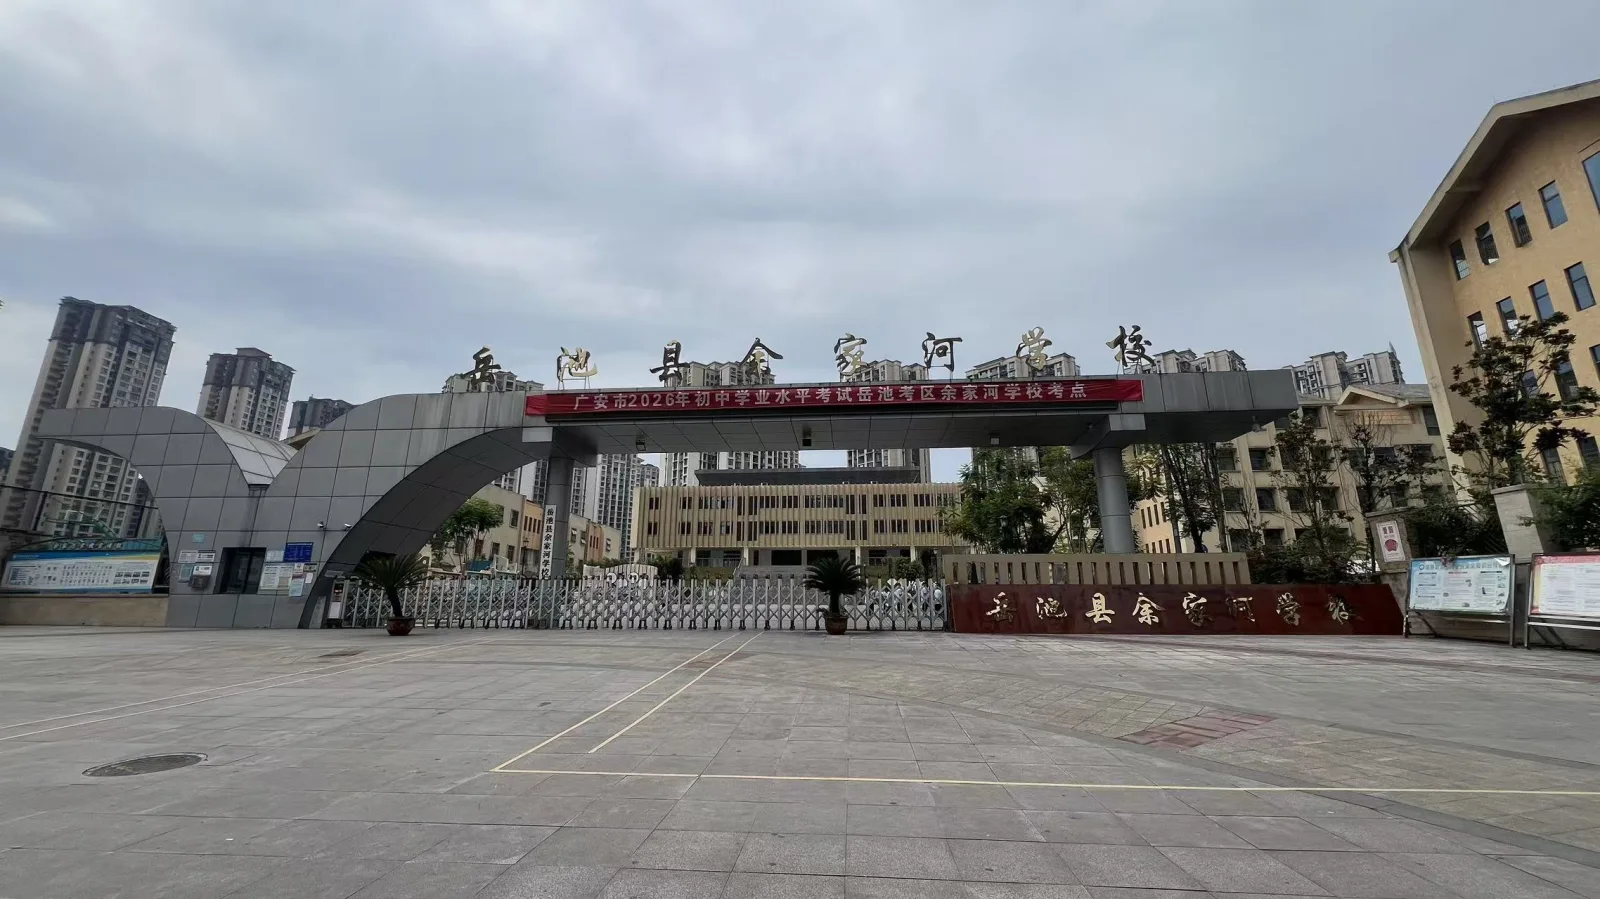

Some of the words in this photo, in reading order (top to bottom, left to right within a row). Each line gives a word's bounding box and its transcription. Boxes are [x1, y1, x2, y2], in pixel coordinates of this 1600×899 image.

[460, 325, 1156, 385] 岳池县余家河学校
[573, 381, 1088, 410] 广安市2026年初中学业水平考试岳池考区余家河学校考点
[541, 507, 554, 578] 岳池县余家河学校
